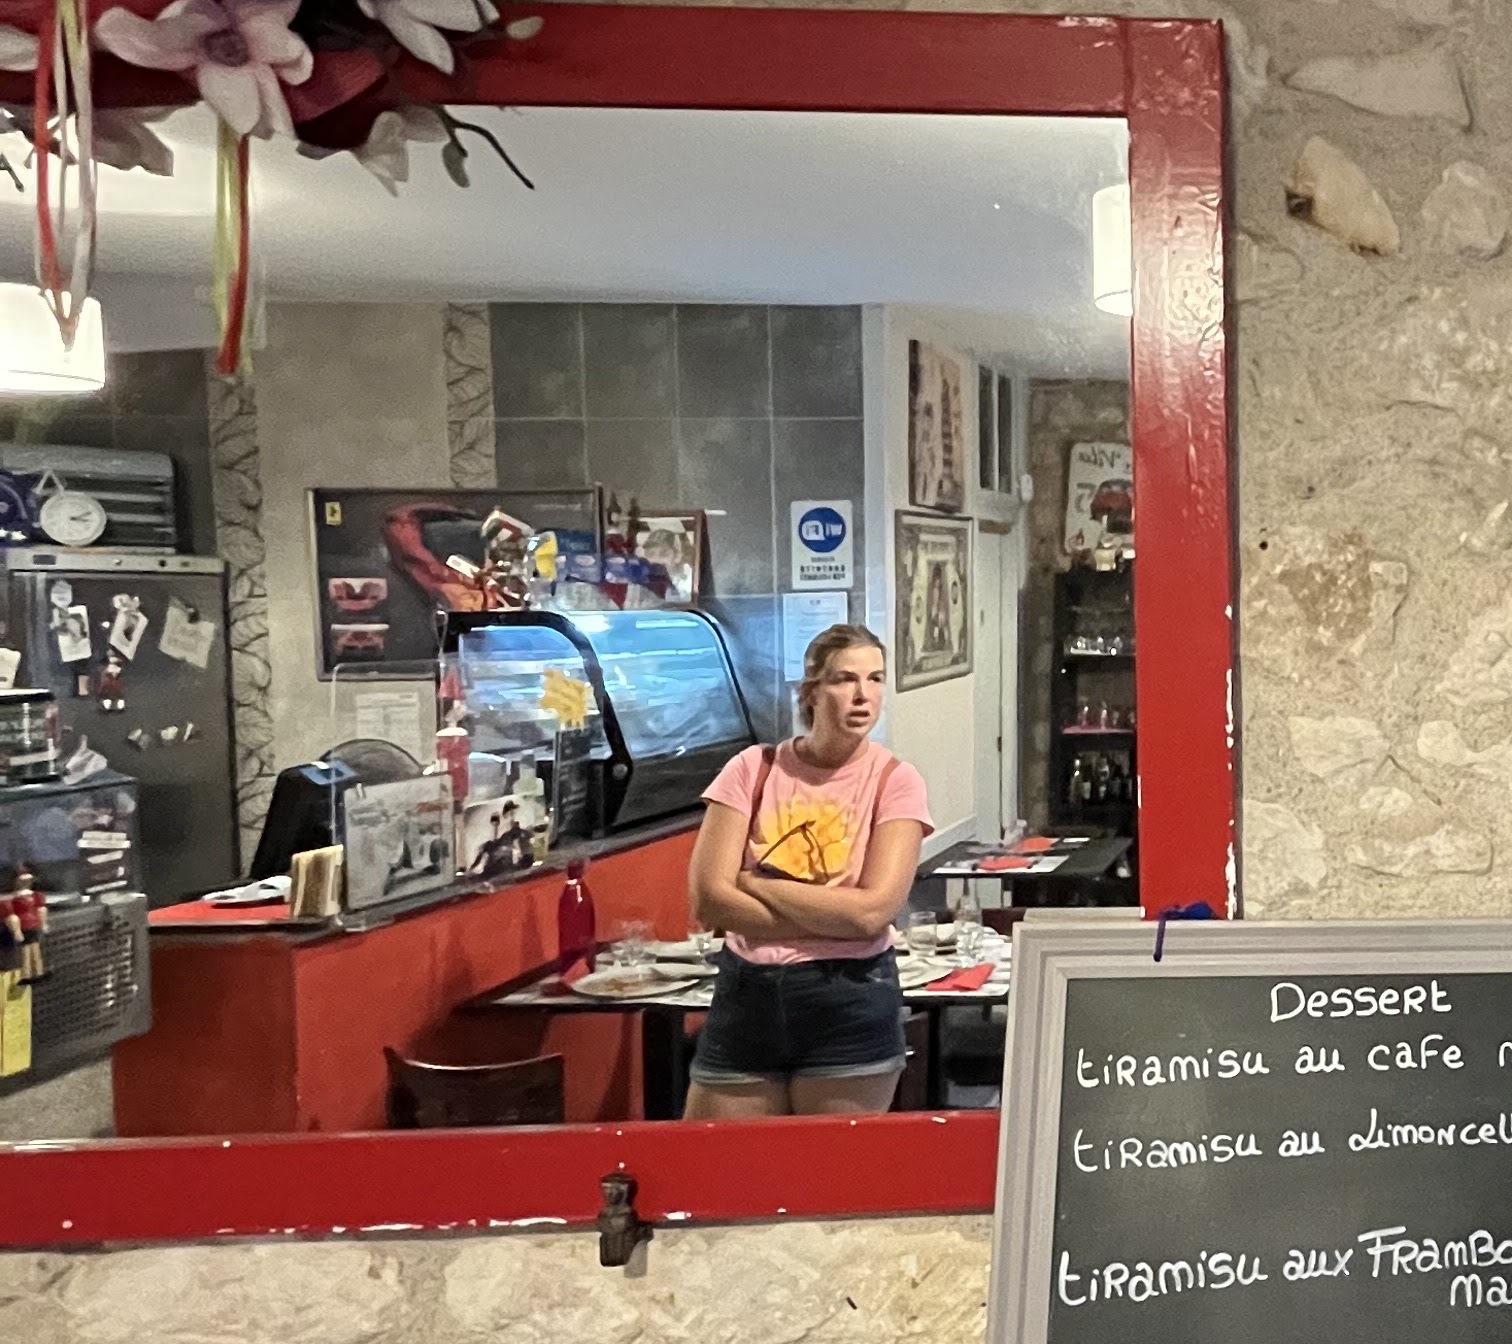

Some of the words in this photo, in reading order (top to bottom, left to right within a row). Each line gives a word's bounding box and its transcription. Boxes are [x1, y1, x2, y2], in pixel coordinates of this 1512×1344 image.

[1270, 979, 1453, 1023] Dessert
[1075, 1047, 1271, 1088] tiramisu
[1294, 1045, 1346, 1074] au
[1073, 1128, 1263, 1173] tiramisu
[1277, 1129, 1326, 1157] au
[1058, 1250, 1269, 1307] tiramisu
[1282, 1249, 1354, 1282] aux
